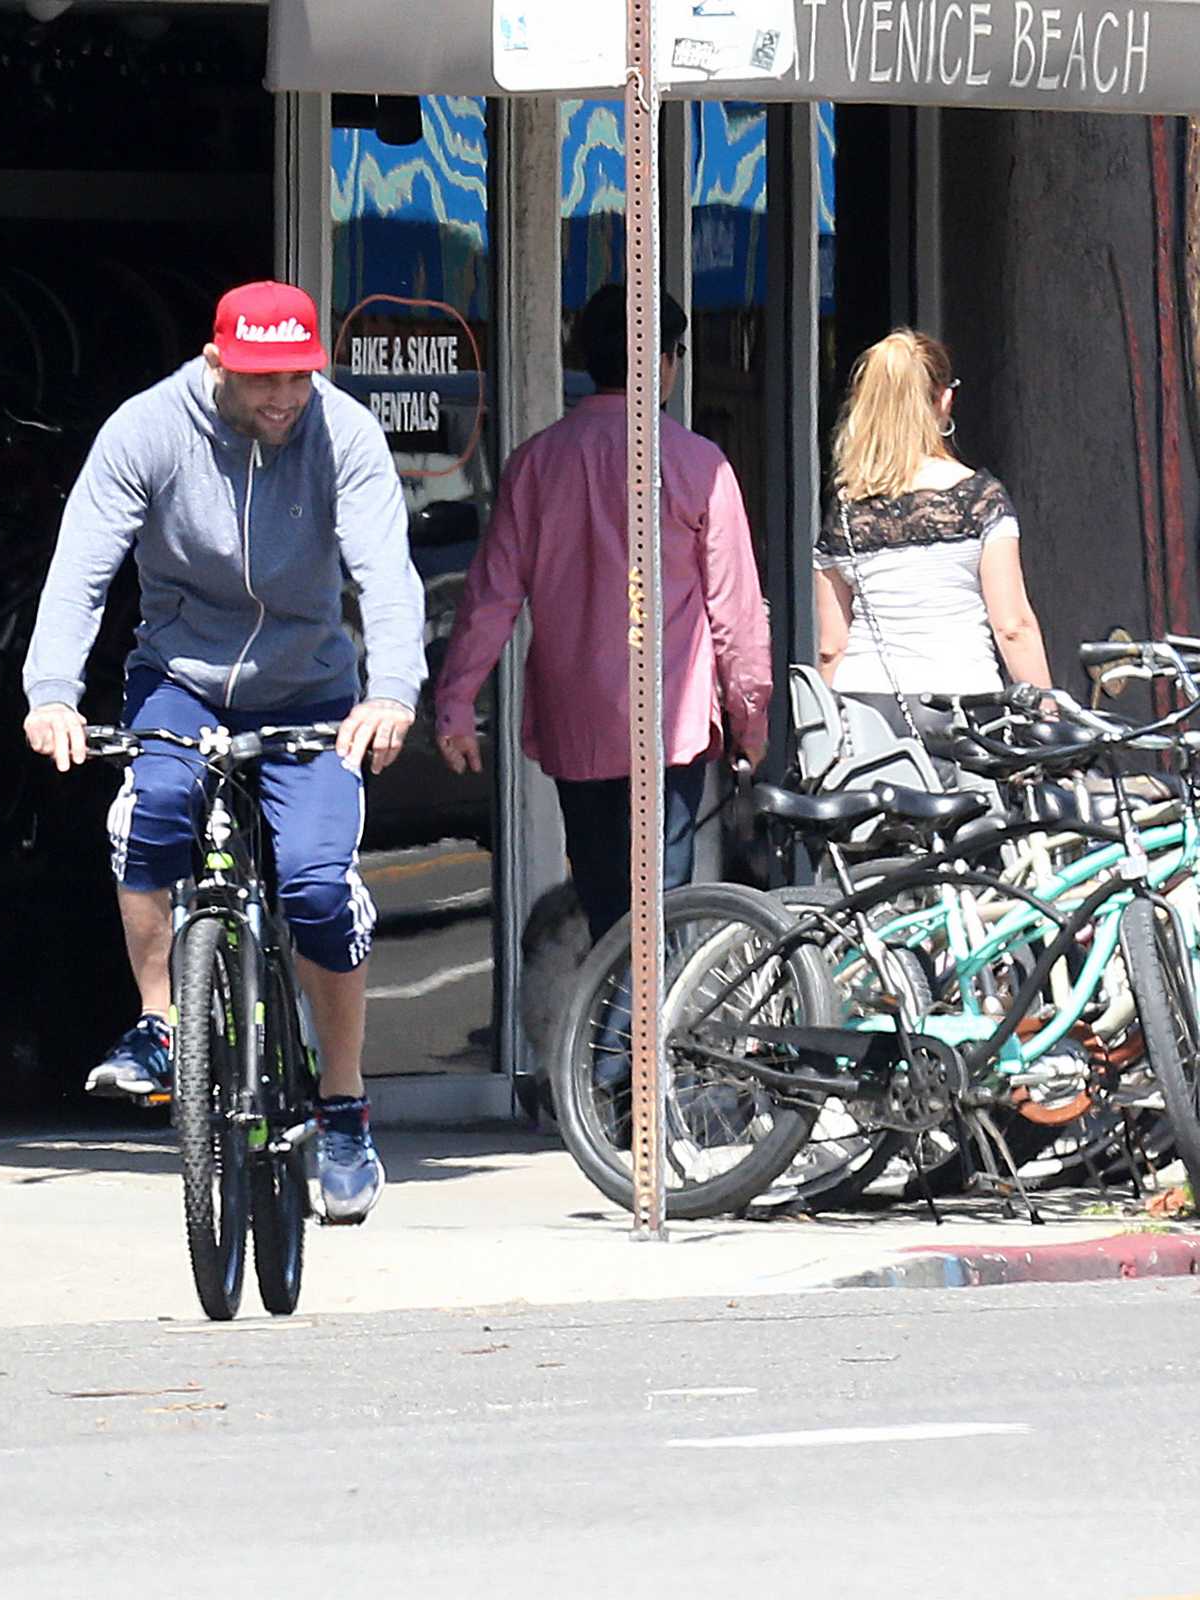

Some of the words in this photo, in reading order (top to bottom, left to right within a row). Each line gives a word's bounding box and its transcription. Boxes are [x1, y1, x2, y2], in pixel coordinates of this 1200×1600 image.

[842, 0, 991, 85] VENICE
[1009, 1, 1149, 94] BEACH
[351, 337, 389, 374] BIKE
[392, 337, 404, 374] &
[407, 336, 458, 374] SKATE
[370, 391, 440, 431] RENTALS
